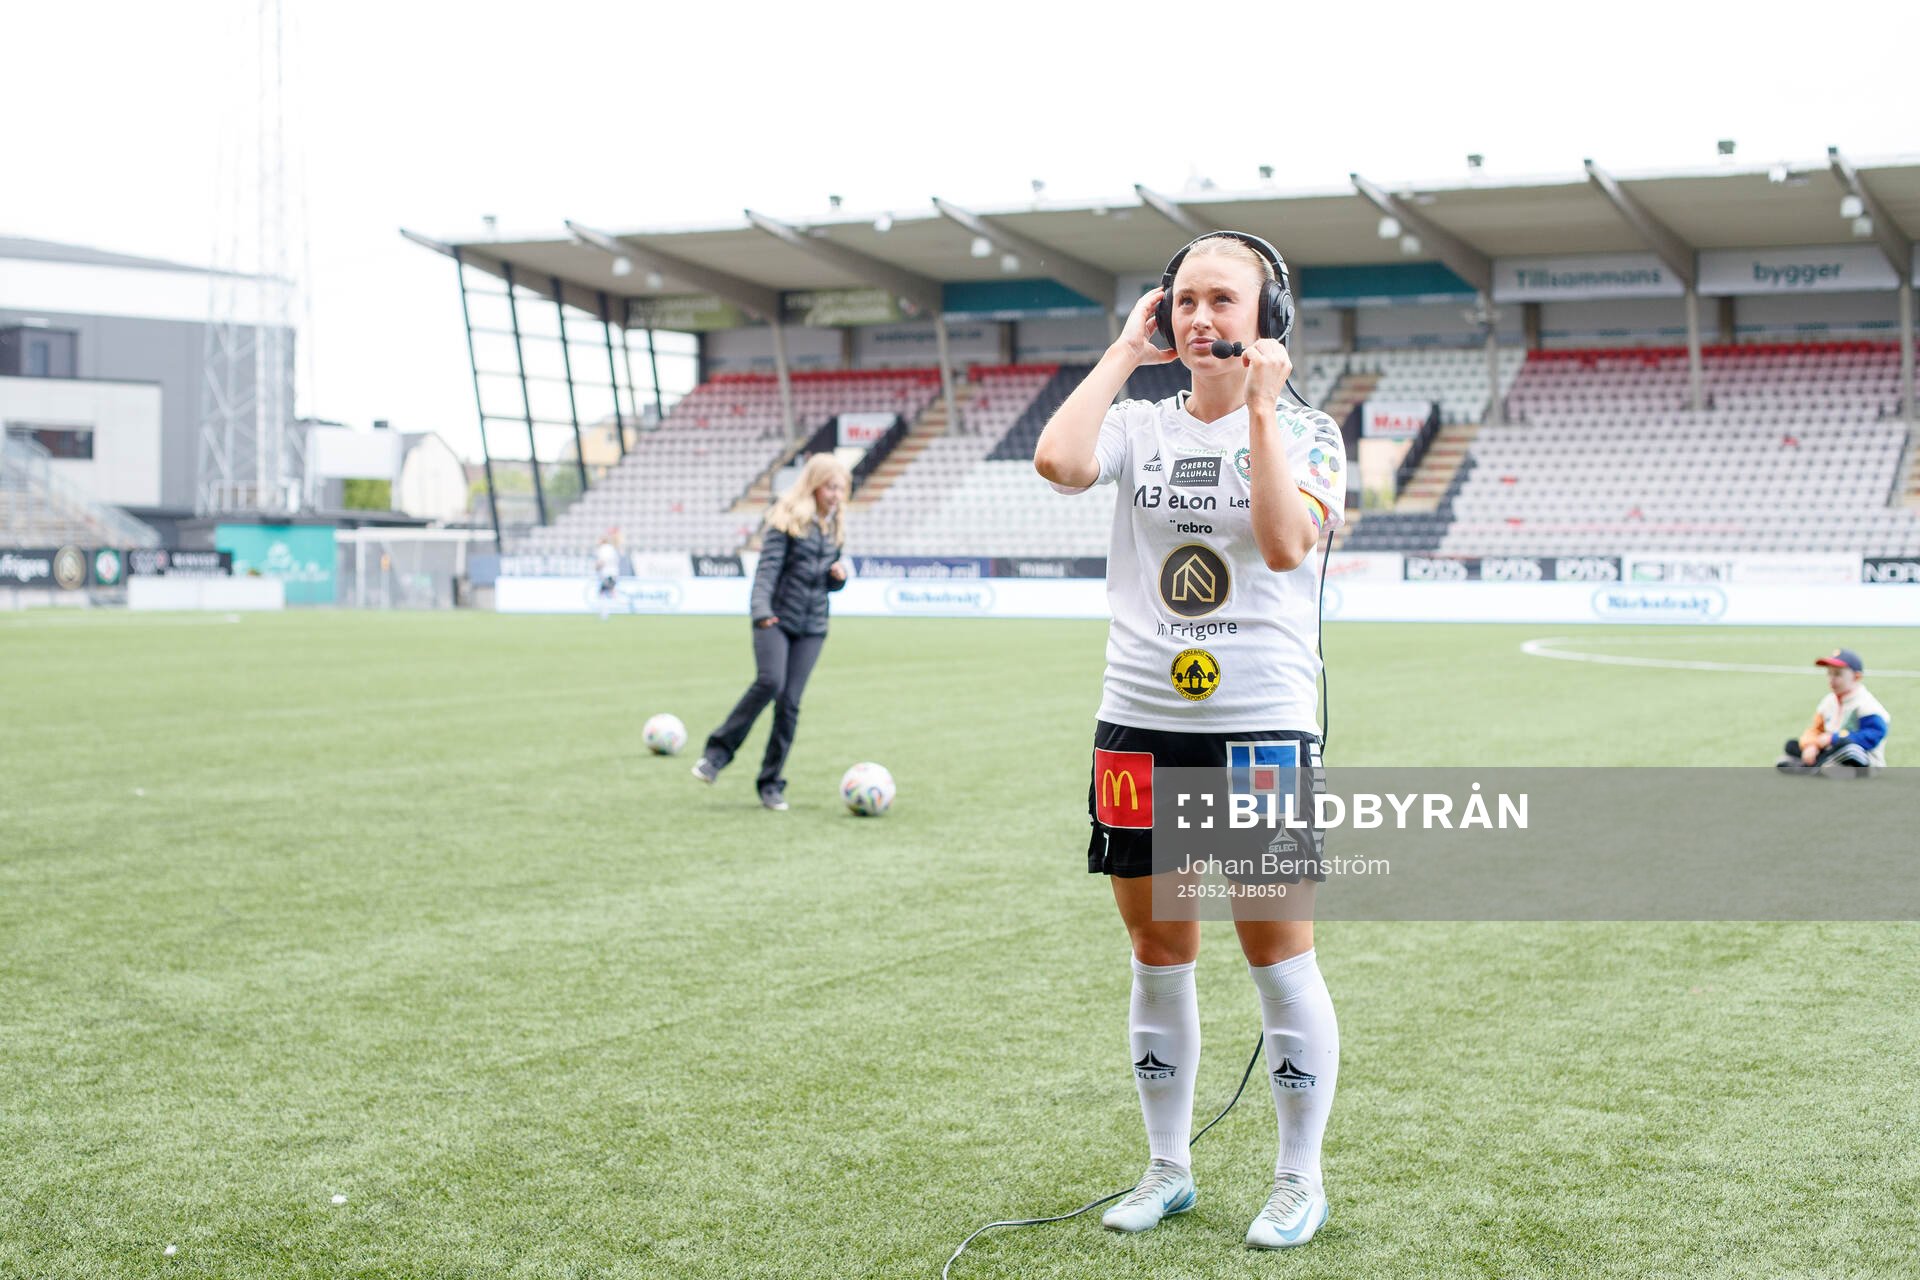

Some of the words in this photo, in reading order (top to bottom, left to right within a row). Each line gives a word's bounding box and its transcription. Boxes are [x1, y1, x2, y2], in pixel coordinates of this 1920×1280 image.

[1515, 266, 1662, 289] Tillsammans
[1753, 260, 1844, 286] bygger
[1180, 460, 1215, 470] ÖREBRO
[1175, 470, 1217, 479] SALUHALL
[1169, 519, 1213, 534] rebro
[1170, 622, 1238, 641] Frigore
[1268, 843, 1298, 853] SELECT
